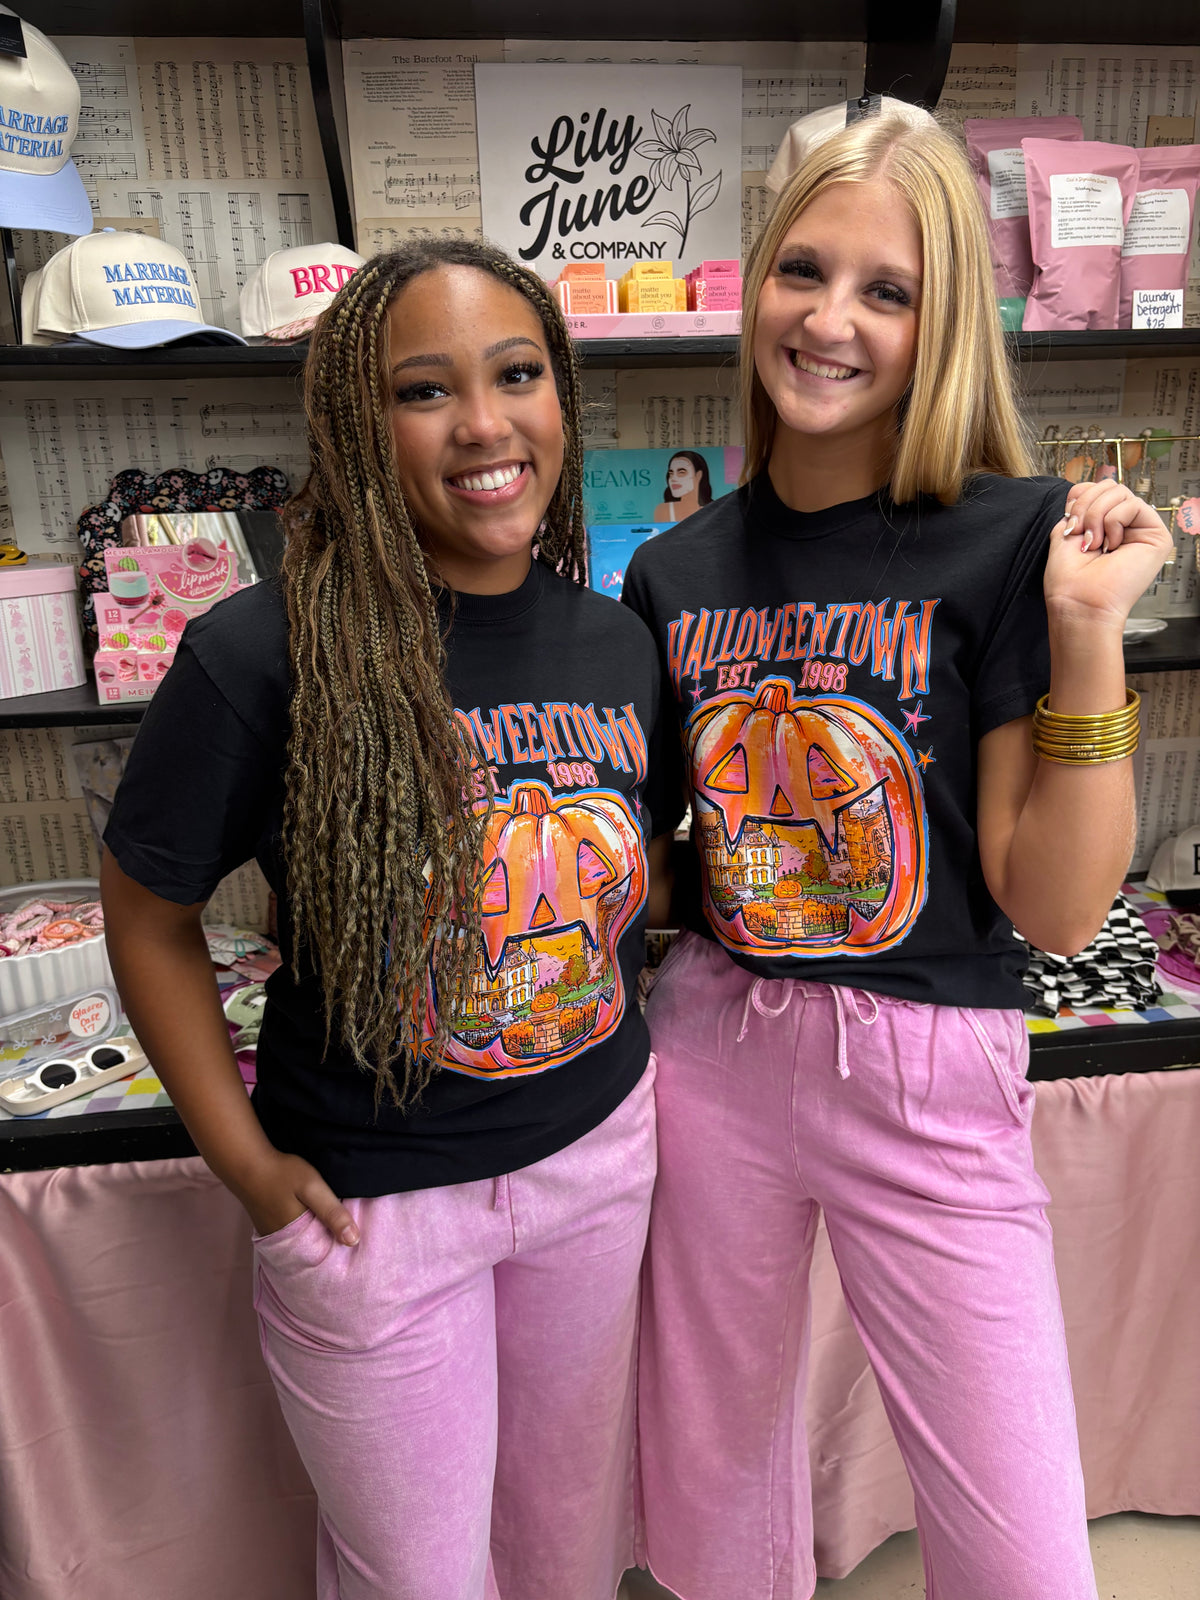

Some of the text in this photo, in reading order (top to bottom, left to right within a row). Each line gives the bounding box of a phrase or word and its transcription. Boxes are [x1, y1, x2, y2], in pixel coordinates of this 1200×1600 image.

[392, 55, 410, 64] The
[414, 54, 453, 64] Barefoot
[525, 107, 643, 184] Lily
[518, 175, 656, 261] June
[552, 241, 667, 259] & COMPANY
[102, 262, 191, 287] MARRIAGE
[112, 285, 197, 309] MATERIAL
[592, 294, 604, 302] you
[660, 293, 672, 301] you
[728, 291, 740, 299] you
[1139, 291, 1175, 304] Laundry
[1137, 303, 1181, 319] Detergent
[1146, 317, 1165, 329] $25
[107, 610, 118, 618] 12
[667, 597, 942, 702] HALLOWEENTOWN
[715, 659, 849, 693] EST. 1998
[461, 761, 600, 800] ST. 1998
